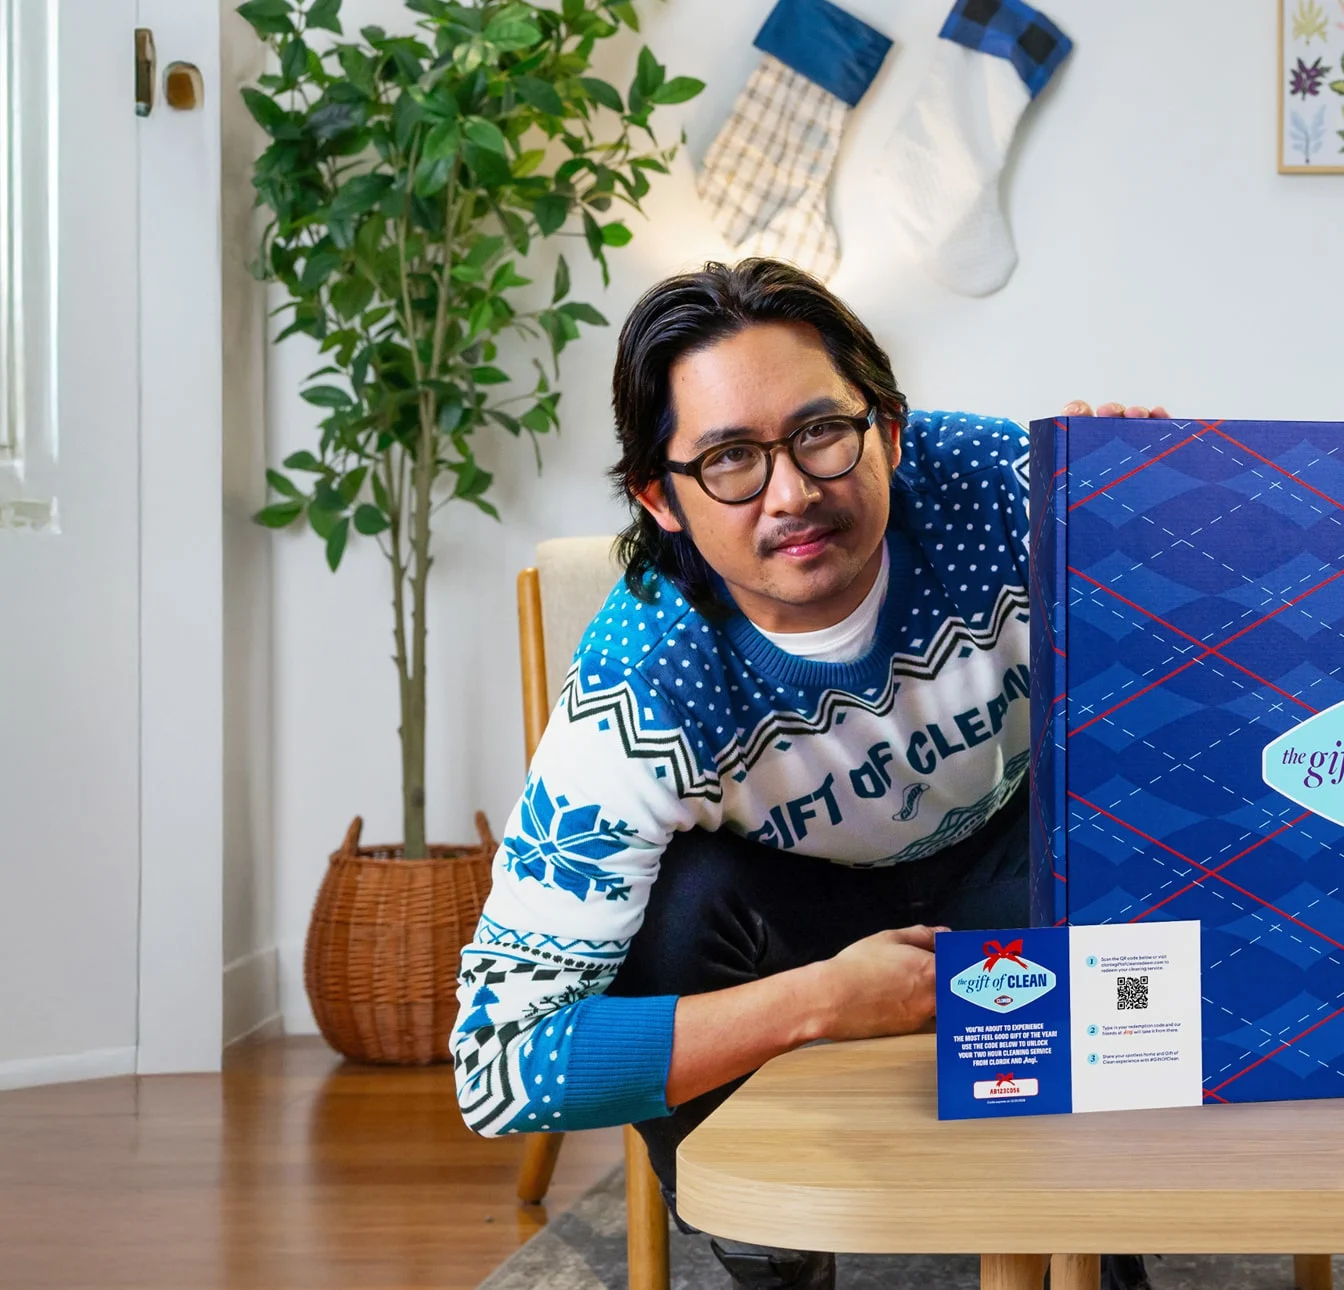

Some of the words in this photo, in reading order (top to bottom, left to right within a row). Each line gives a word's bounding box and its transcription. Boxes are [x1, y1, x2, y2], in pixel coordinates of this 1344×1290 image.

[850, 741, 893, 799] OF
[906, 664, 1030, 775] CLEAN
[1282, 748, 1306, 764] the
[967, 975, 991, 993] gift
[993, 974, 1007, 991] of
[1008, 974, 1047, 989] CLEAN
